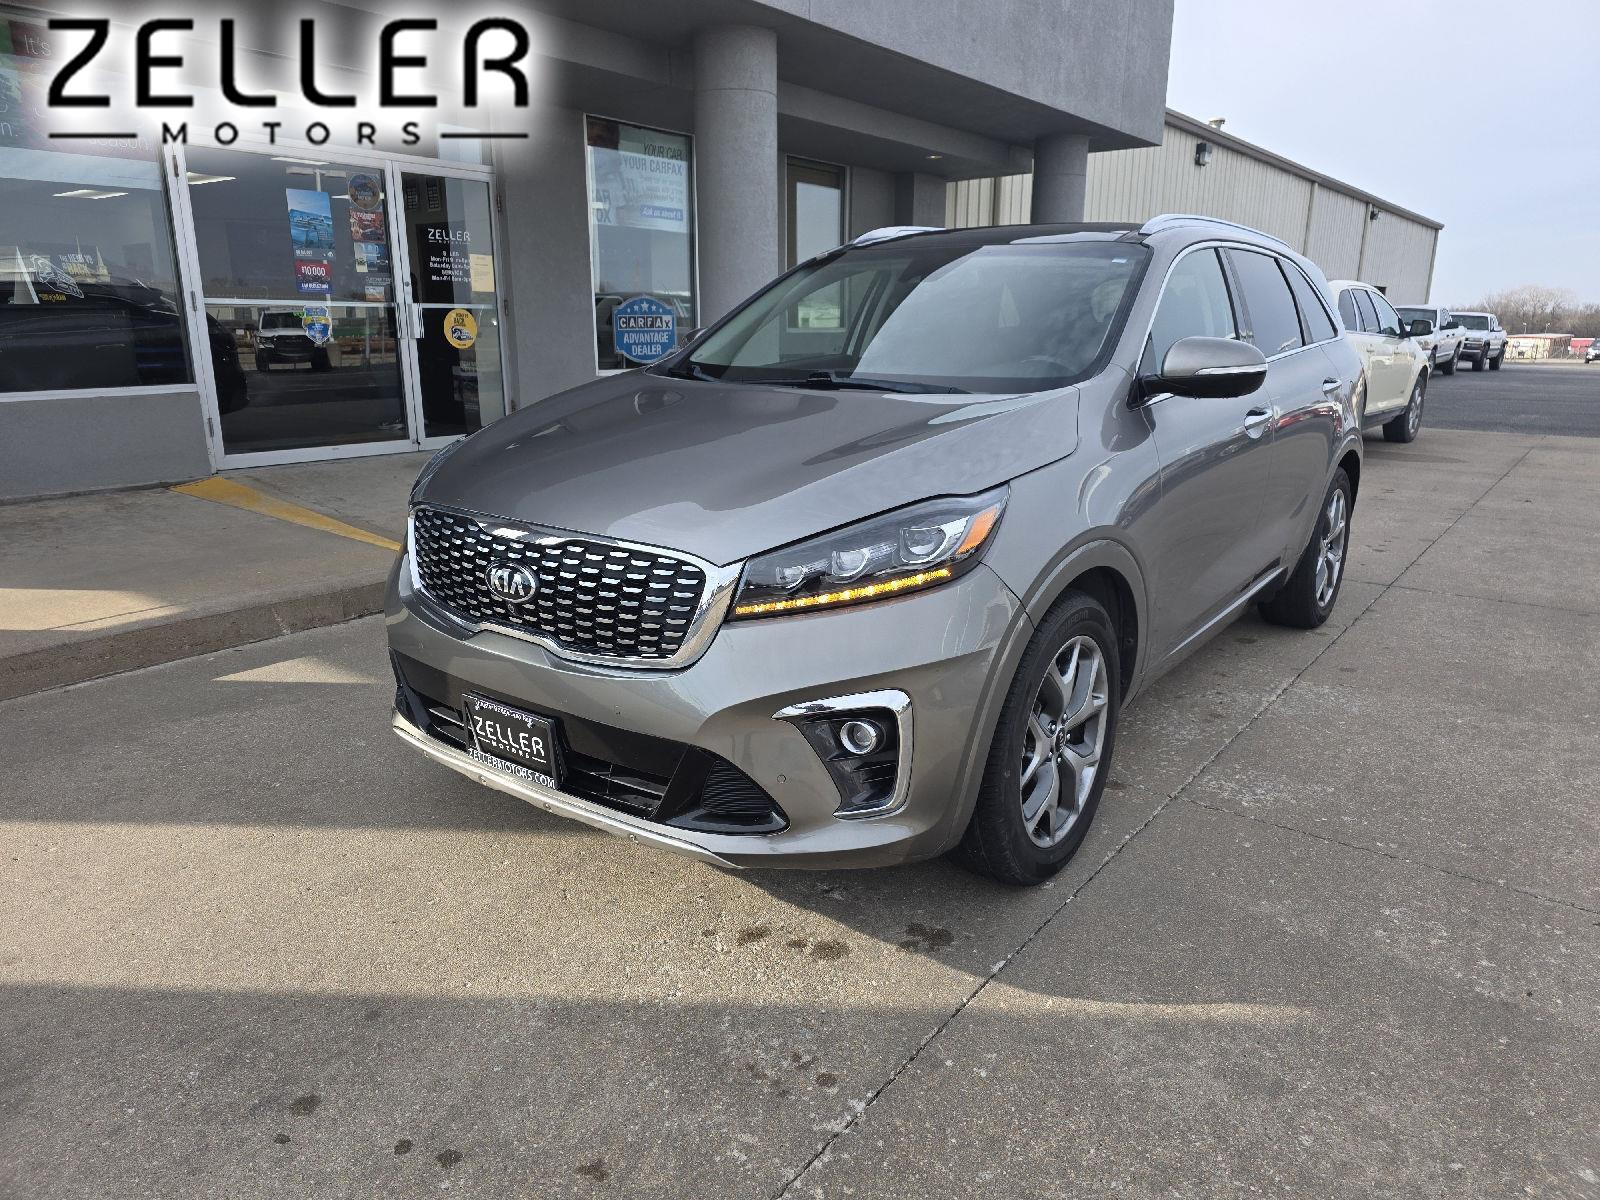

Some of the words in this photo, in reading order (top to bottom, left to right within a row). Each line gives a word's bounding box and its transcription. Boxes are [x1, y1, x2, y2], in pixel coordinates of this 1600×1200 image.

[643, 143, 665, 158] YOUR
[621, 155, 647, 171] YOUR
[649, 160, 683, 176] CARFAX
[427, 228, 471, 242] ZELLER
[619, 317, 672, 329] CARFAX
[623, 331, 669, 344] ADVANTAGE
[631, 344, 662, 356] DEALER
[473, 715, 545, 757] ZELLER
